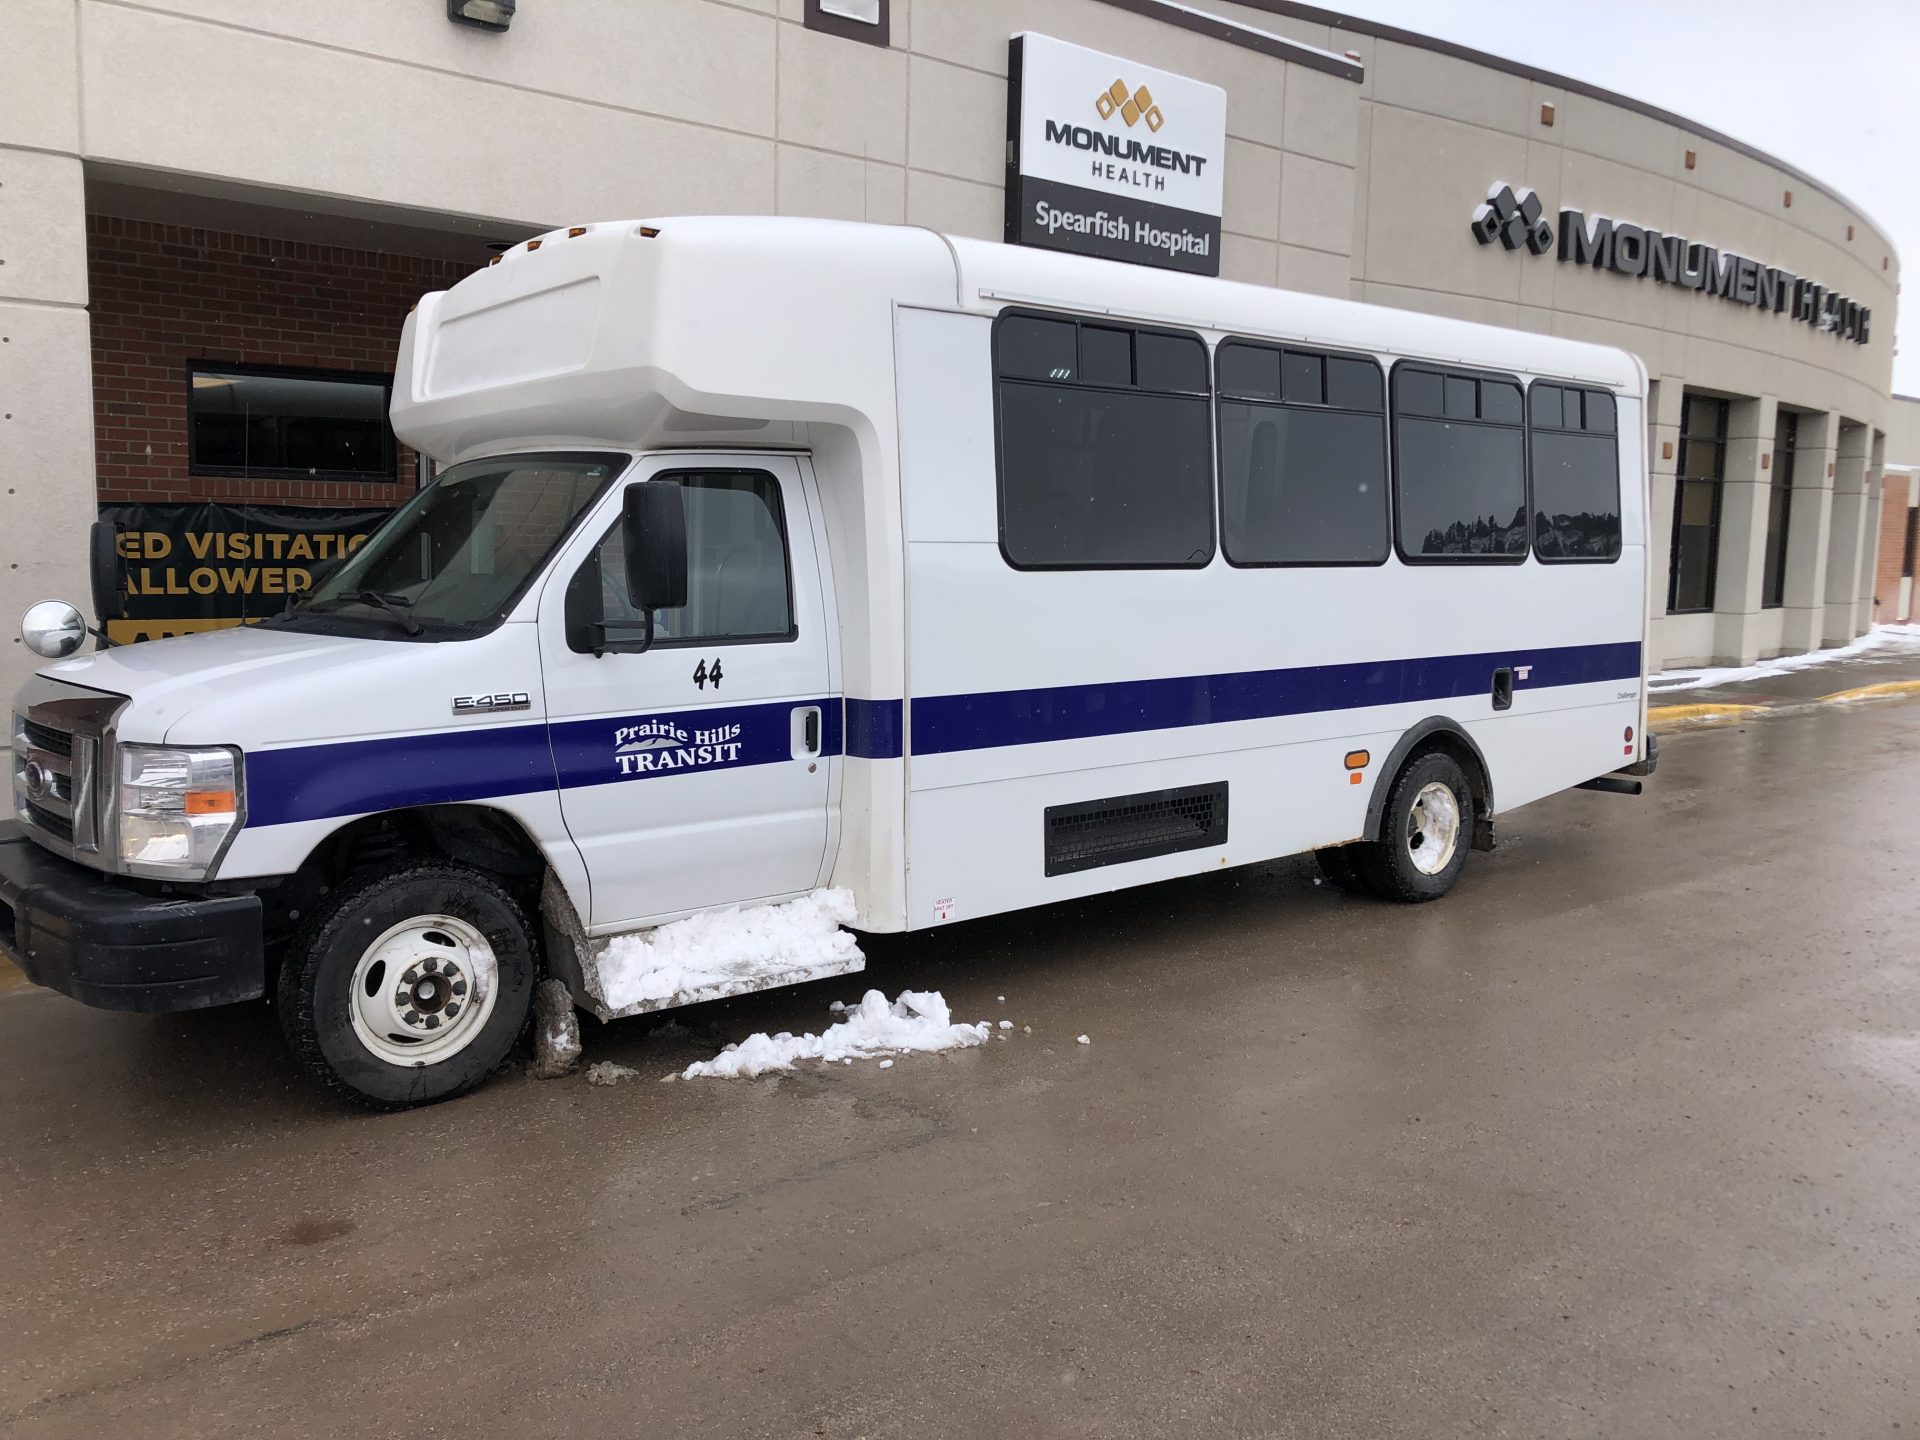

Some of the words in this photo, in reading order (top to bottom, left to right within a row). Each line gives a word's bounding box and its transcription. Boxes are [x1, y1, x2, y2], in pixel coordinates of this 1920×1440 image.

[1045, 119, 1207, 177] MONUMENT
[1091, 160, 1165, 191] HEALTH
[1035, 200, 1130, 241] Spearfish
[1134, 220, 1210, 257] Hospital
[1557, 208, 1797, 314] MONUMENT
[116, 531, 172, 559] ED
[692, 657, 724, 691] 44
[614, 719, 689, 747] Prairie
[694, 723, 741, 746] Hills
[615, 742, 742, 775] TRANSIT
